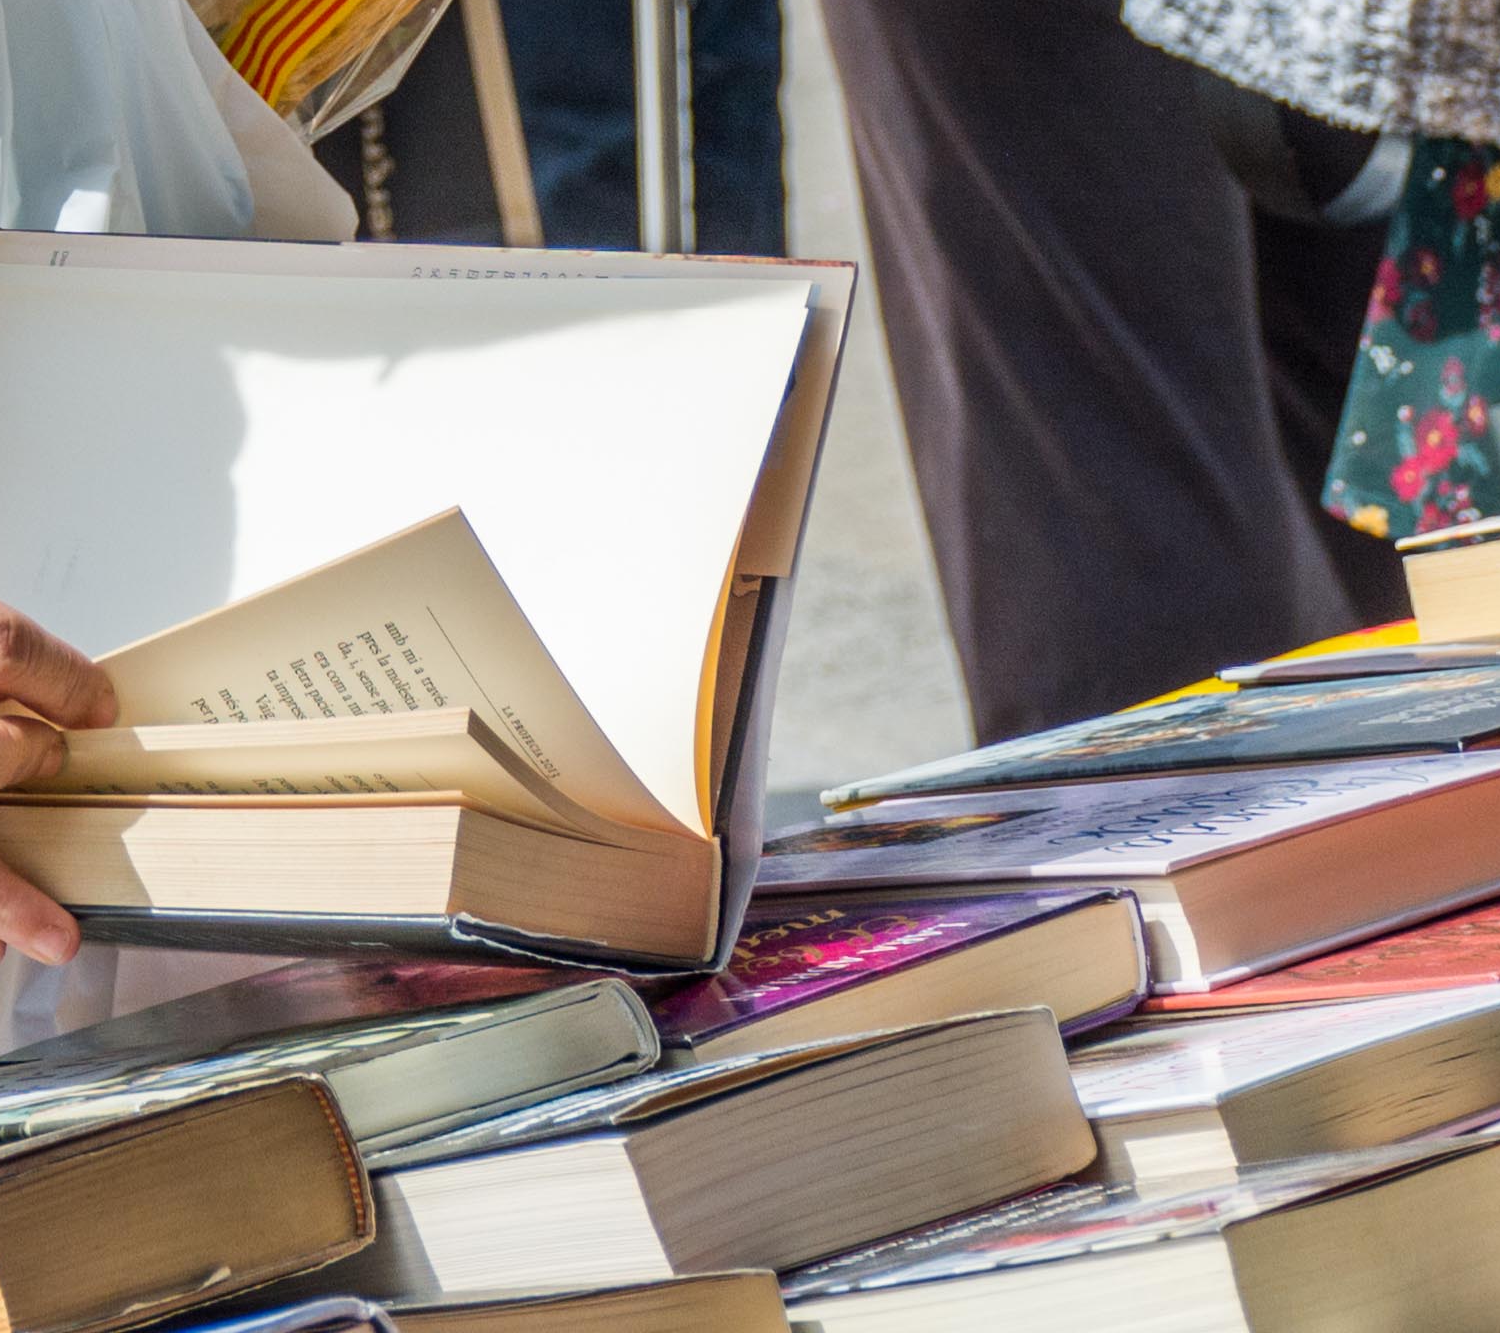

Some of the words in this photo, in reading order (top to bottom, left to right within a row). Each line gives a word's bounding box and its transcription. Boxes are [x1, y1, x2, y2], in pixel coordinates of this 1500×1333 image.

[266, 669, 280, 684] ta
[289, 657, 315, 690] lletra
[313, 650, 331, 670] era
[326, 668, 347, 694] com
[337, 639, 353, 661] da,
[355, 669, 381, 698] sense
[356, 630, 382, 657] pres
[377, 654, 390, 669] la
[386, 667, 420, 712] molèstia
[384, 619, 407, 647] amb
[402, 647, 424, 667] mi
[414, 666, 425, 677] a
[421, 675, 450, 709] través
[191, 697, 214, 718] per
[218, 688, 239, 710] més
[254, 693, 276, 721] Vaig
[501, 705, 515, 721] LA
[511, 717, 545, 761] PROFECIA
[541, 756, 561, 782] 2013
